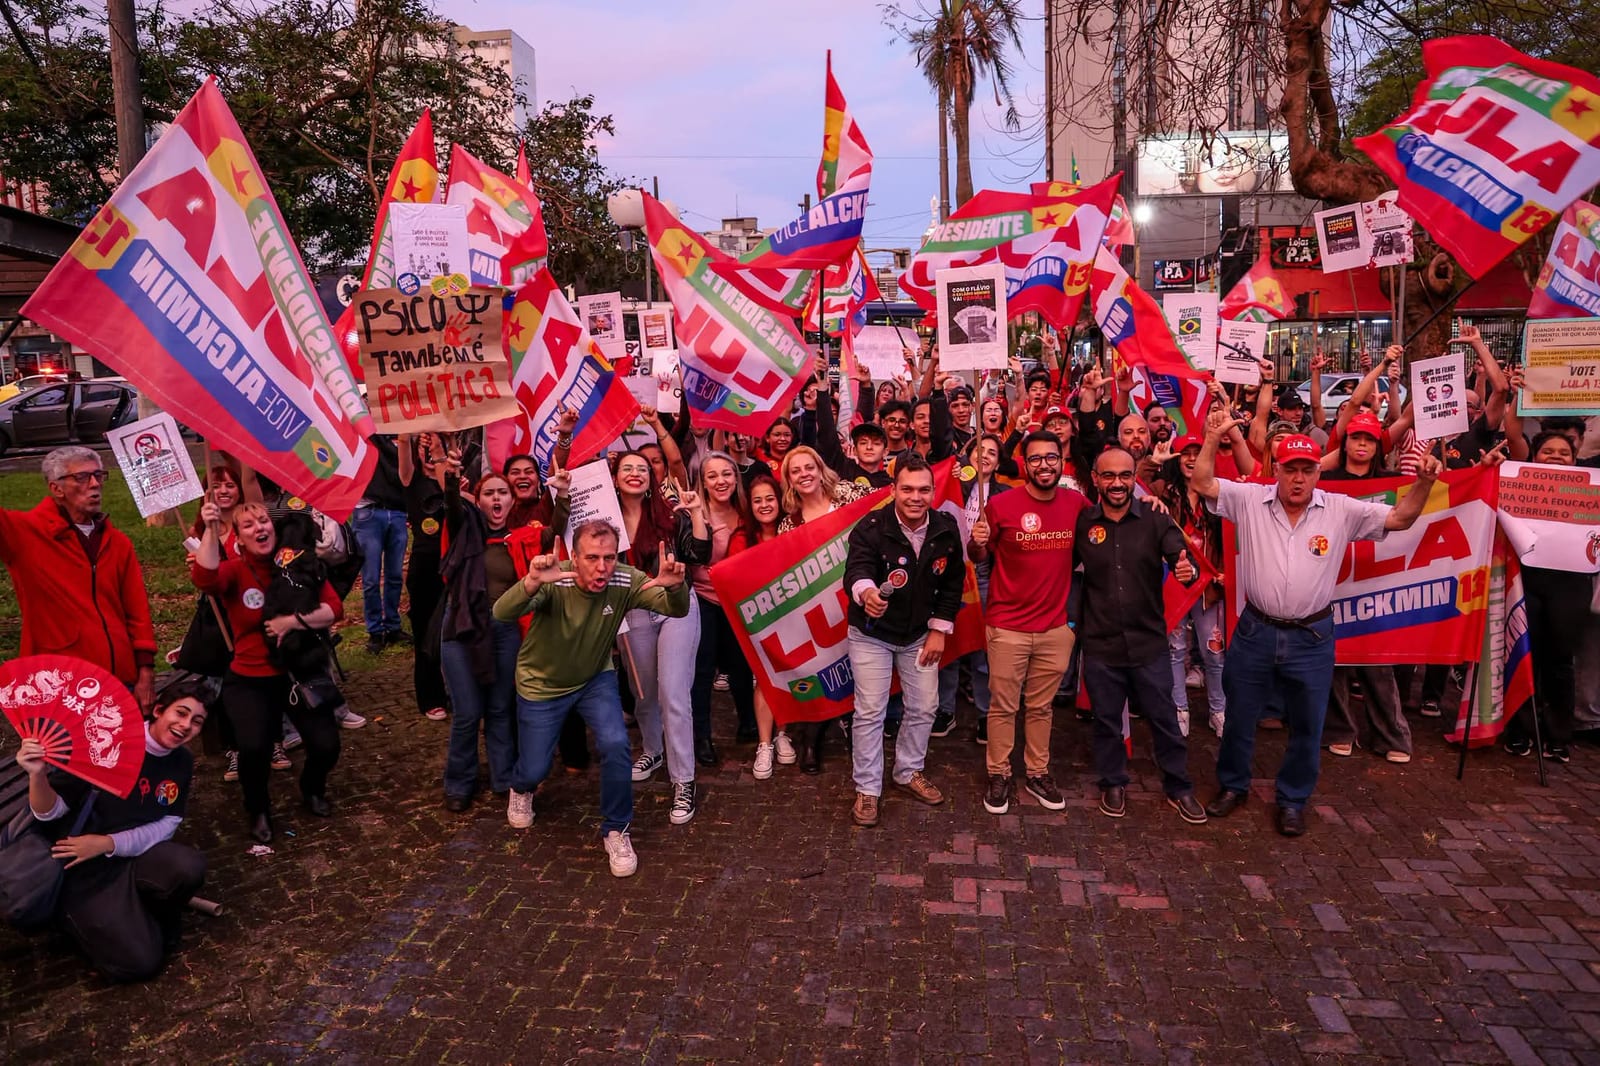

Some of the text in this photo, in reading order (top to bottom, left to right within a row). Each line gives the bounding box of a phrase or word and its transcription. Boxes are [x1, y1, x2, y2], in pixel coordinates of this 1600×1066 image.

[1413, 146, 1518, 216] ALCKMIN
[1511, 205, 1553, 234] 13
[774, 219, 809, 244] VICE
[1288, 236, 1309, 246] Lojas
[1066, 263, 1091, 287] 13
[359, 295, 447, 343] PSICO
[1570, 366, 1596, 376] VOTE
[1561, 379, 1590, 389] LULA
[1287, 441, 1313, 450] LULA
[1522, 470, 1584, 483] O GOVERNO
[1499, 480, 1545, 492] DERRUBA
[1548, 485, 1555, 493] A
[1518, 494, 1539, 504] QUE
[1541, 496, 1548, 504] A
[1551, 497, 1600, 511] EDUCAÇÃ
[1513, 505, 1559, 519] DERRUBE
[1561, 511, 1570, 519] O
[1015, 529, 1073, 541] Democracia
[1021, 540, 1071, 551] Socialista
[1317, 538, 1329, 551] 13
[759, 590, 849, 674] LU
